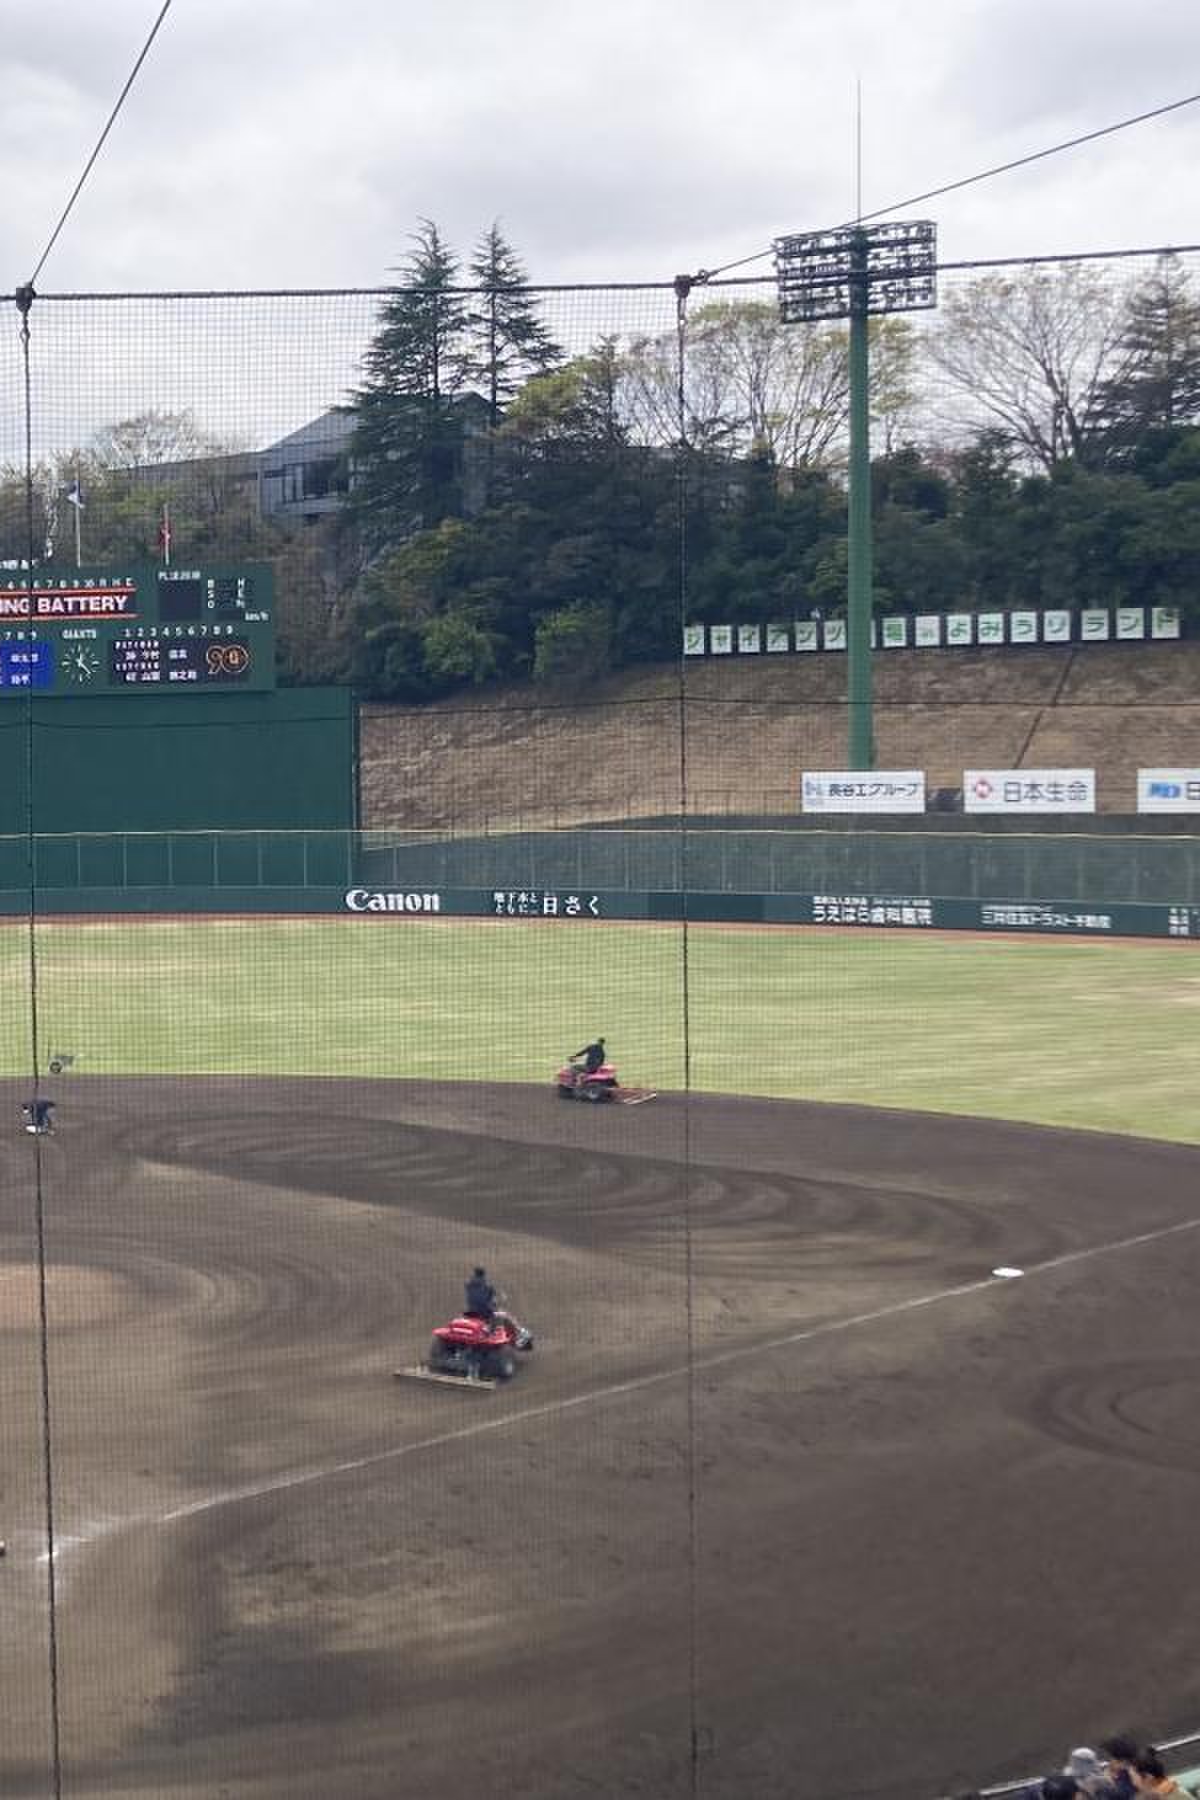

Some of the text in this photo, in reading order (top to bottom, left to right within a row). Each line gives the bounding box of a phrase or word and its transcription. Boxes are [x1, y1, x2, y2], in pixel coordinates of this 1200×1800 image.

[37, 595, 129, 613] BATTERY
[62, 629, 97, 639] GIANTS
[828, 783, 918, 797] 長谷工グループ
[1004, 781, 1089, 802] 日本生命
[345, 890, 441, 912] Canon
[544, 896, 599, 915] 日さく
[813, 905, 933, 925] うえはら歯科医院
